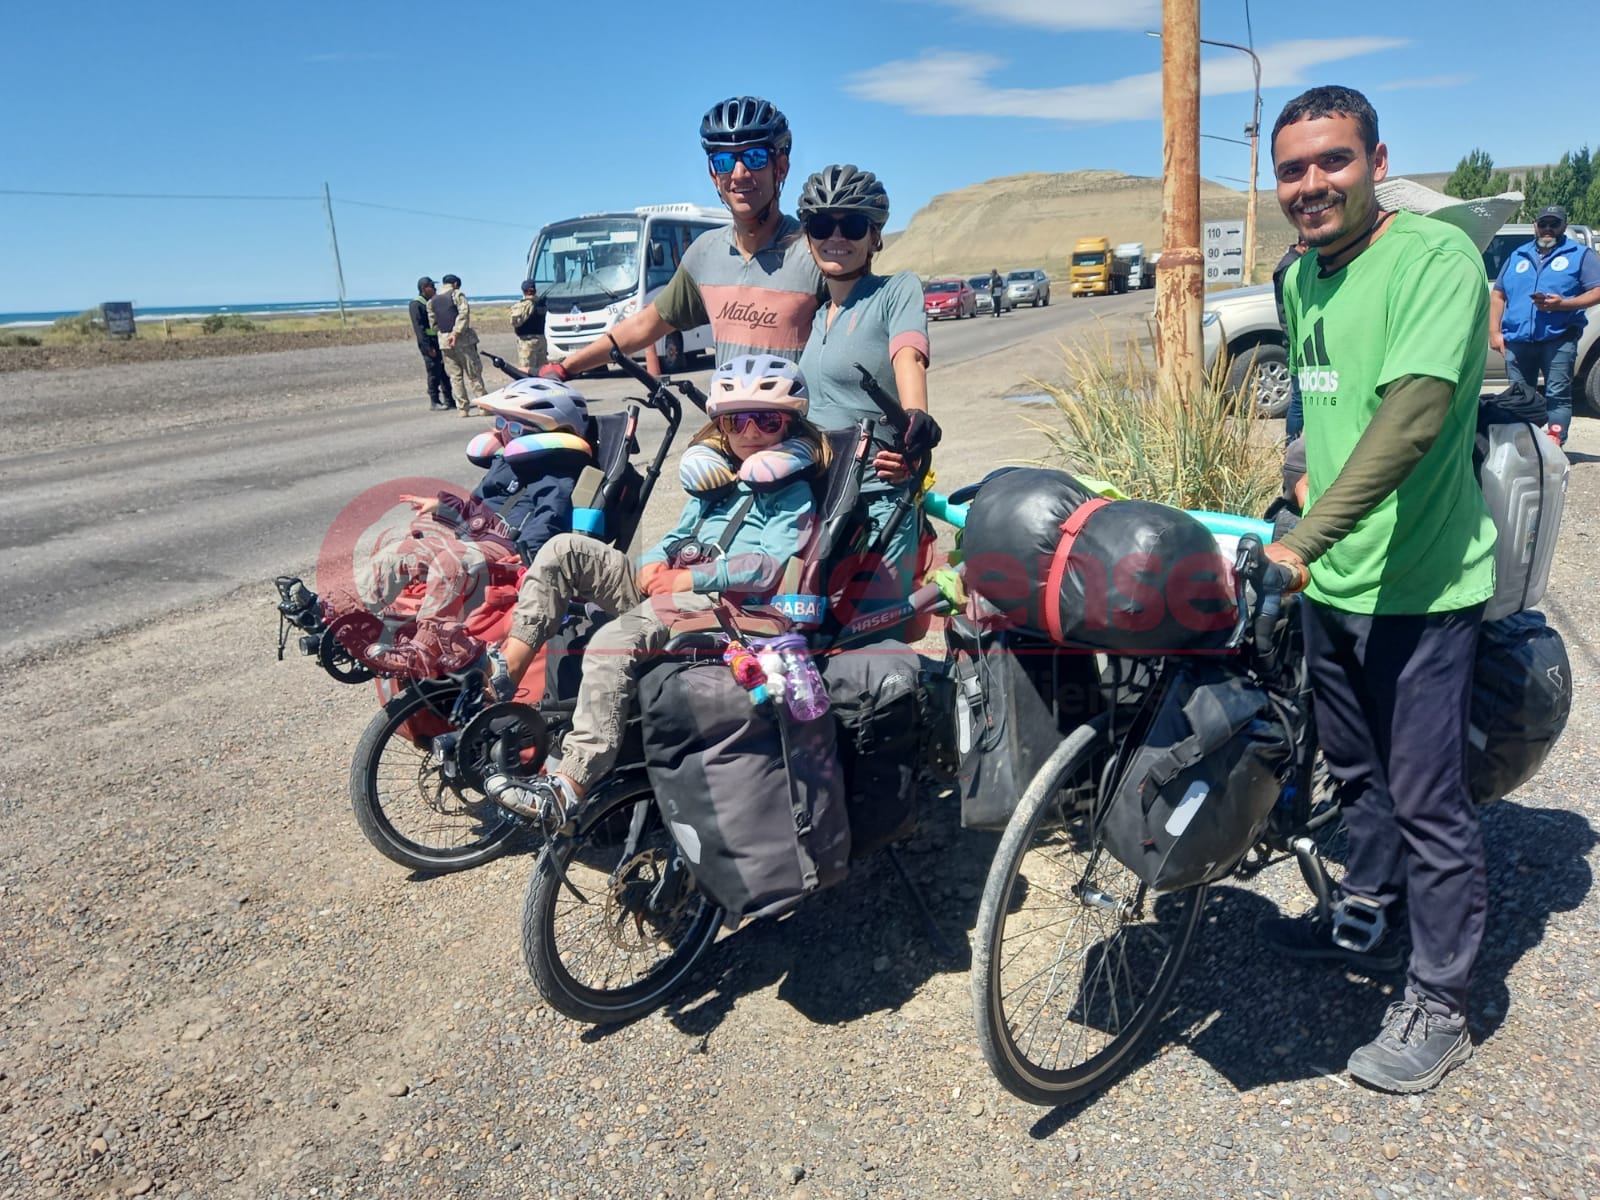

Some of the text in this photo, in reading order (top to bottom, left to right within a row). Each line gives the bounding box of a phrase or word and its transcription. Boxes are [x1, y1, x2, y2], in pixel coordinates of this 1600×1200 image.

[1207, 228, 1221, 238] 110
[1208, 248, 1220, 258] 90
[1207, 268, 1219, 278] 80
[607, 304, 618, 316] 36
